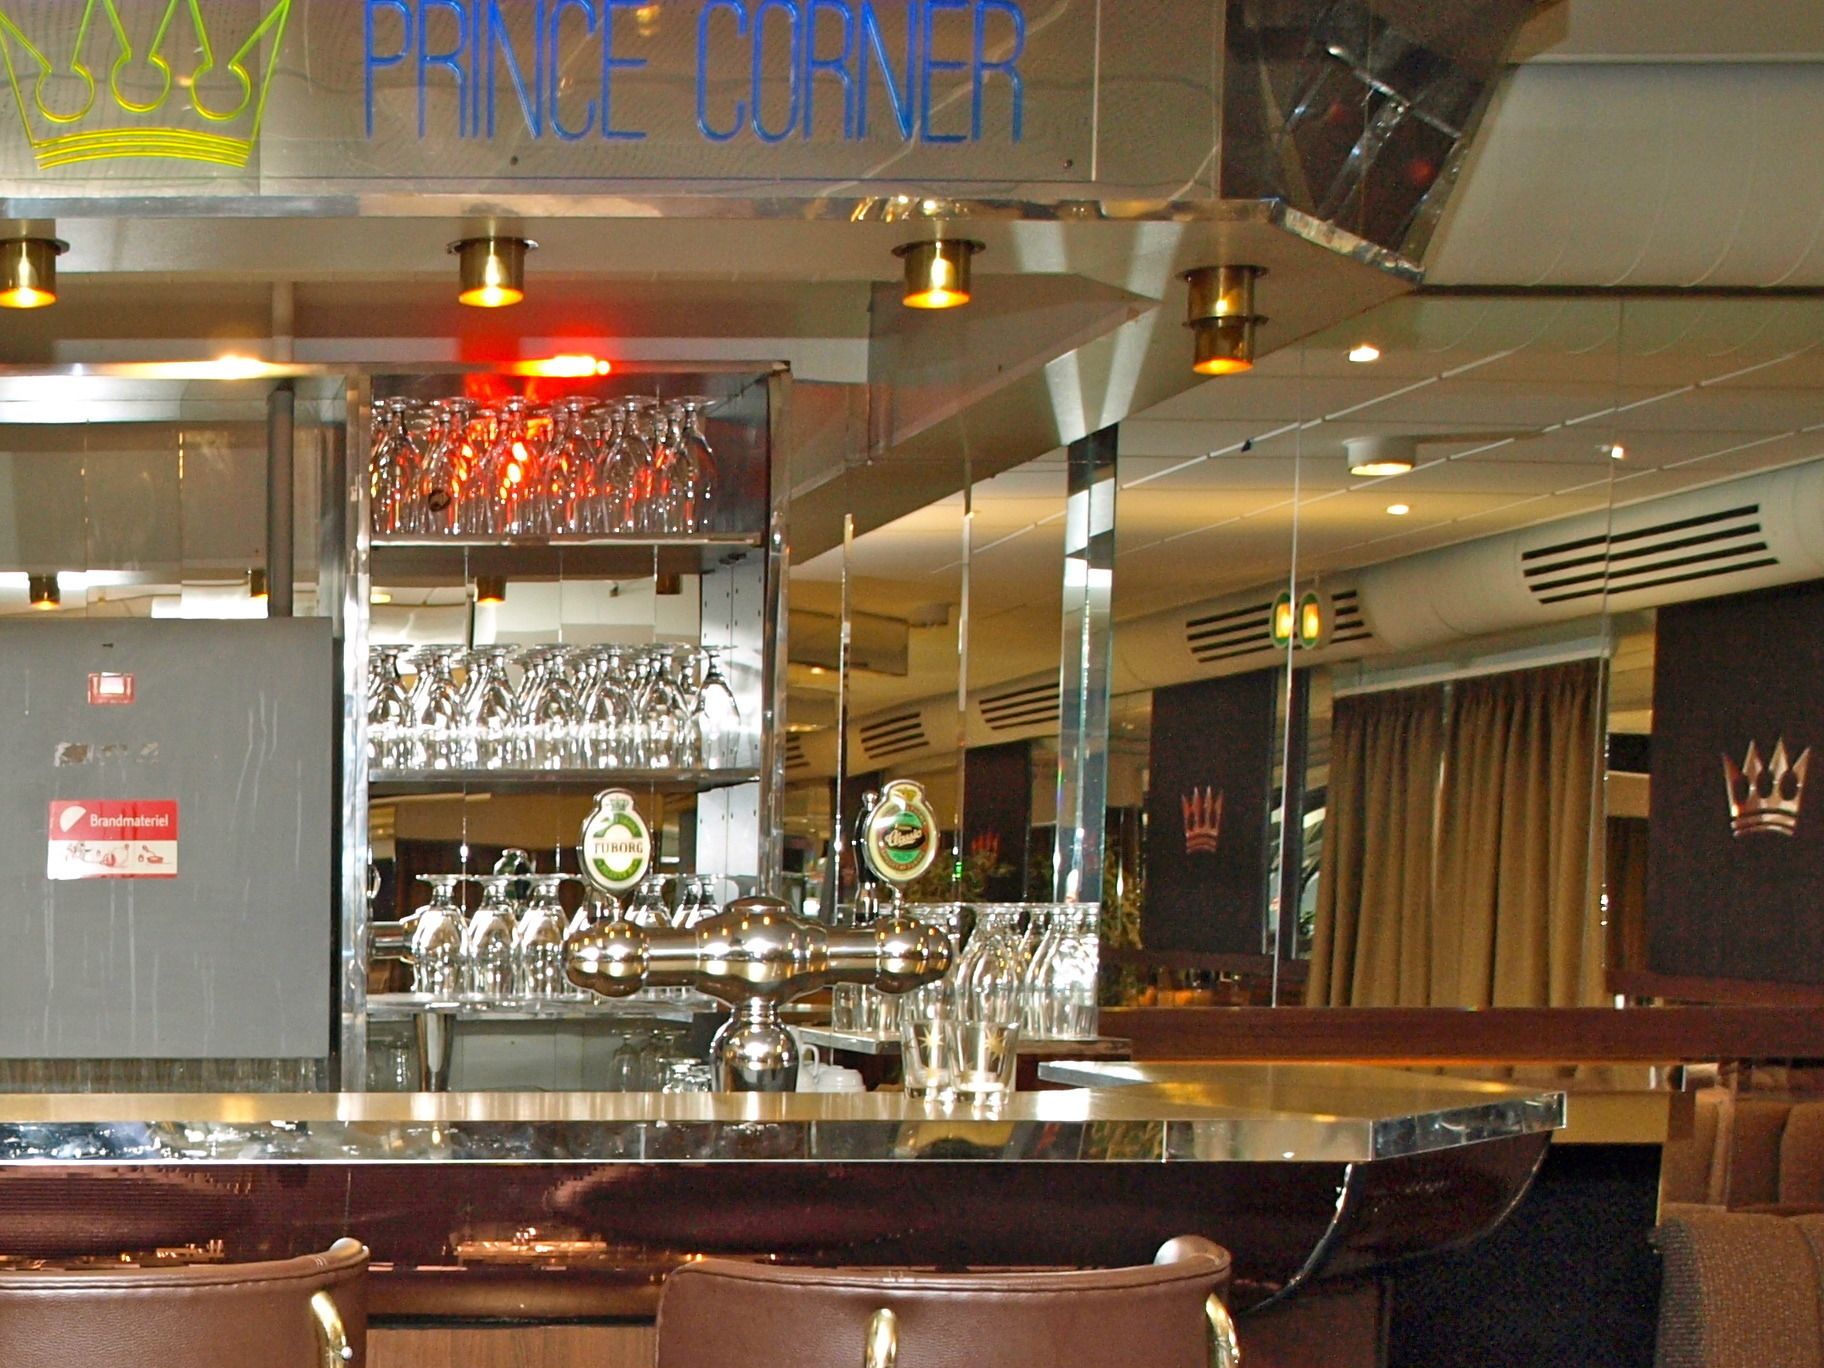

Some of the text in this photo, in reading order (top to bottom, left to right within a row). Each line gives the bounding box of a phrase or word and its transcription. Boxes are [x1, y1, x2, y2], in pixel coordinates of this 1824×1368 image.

[363, 0, 1026, 143] PRINCE CORNER
[89, 813, 169, 828] Brandmateriel
[594, 841, 644, 855] TUBORG
